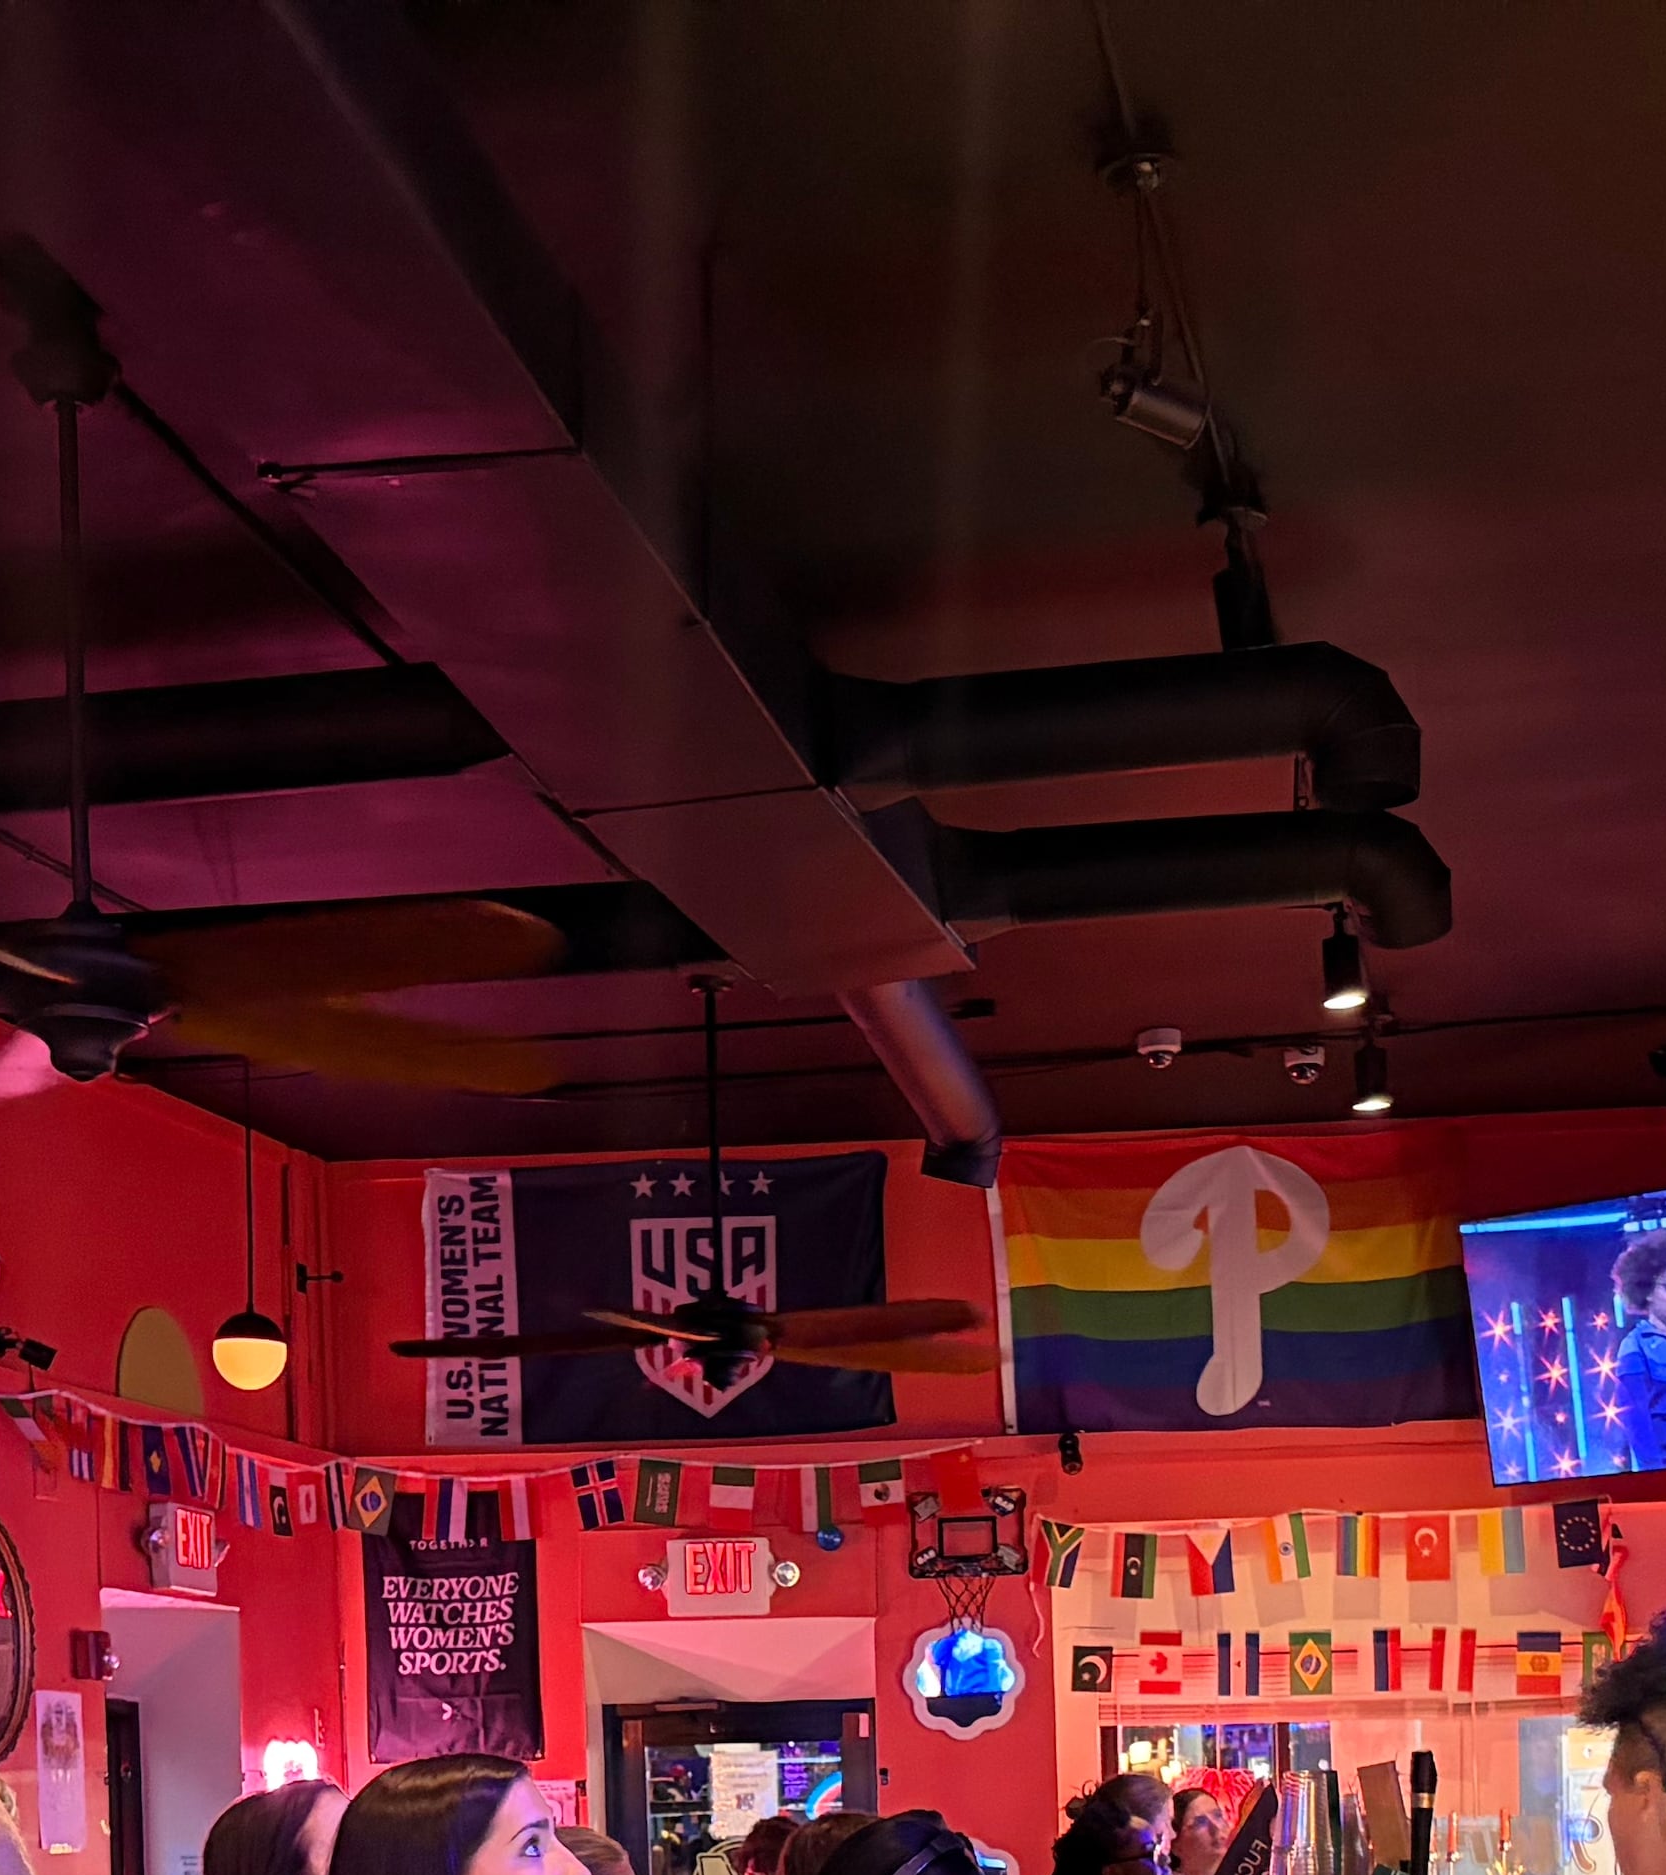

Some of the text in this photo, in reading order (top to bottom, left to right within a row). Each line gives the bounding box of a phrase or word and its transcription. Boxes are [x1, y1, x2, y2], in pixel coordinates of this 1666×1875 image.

[639, 1225, 767, 1300] USA
[1140, 1145, 1330, 1416] P
[468, 1176, 510, 1437] NATINAL TEAM
[176, 1508, 211, 1569] EXIT
[382, 1572, 520, 1600] EVERYONE
[684, 1541, 757, 1595] EXIT
[388, 1597, 515, 1625] WATCHES
[389, 1622, 515, 1649] WOMEN'S
[398, 1648, 507, 1675] SPORTS.
